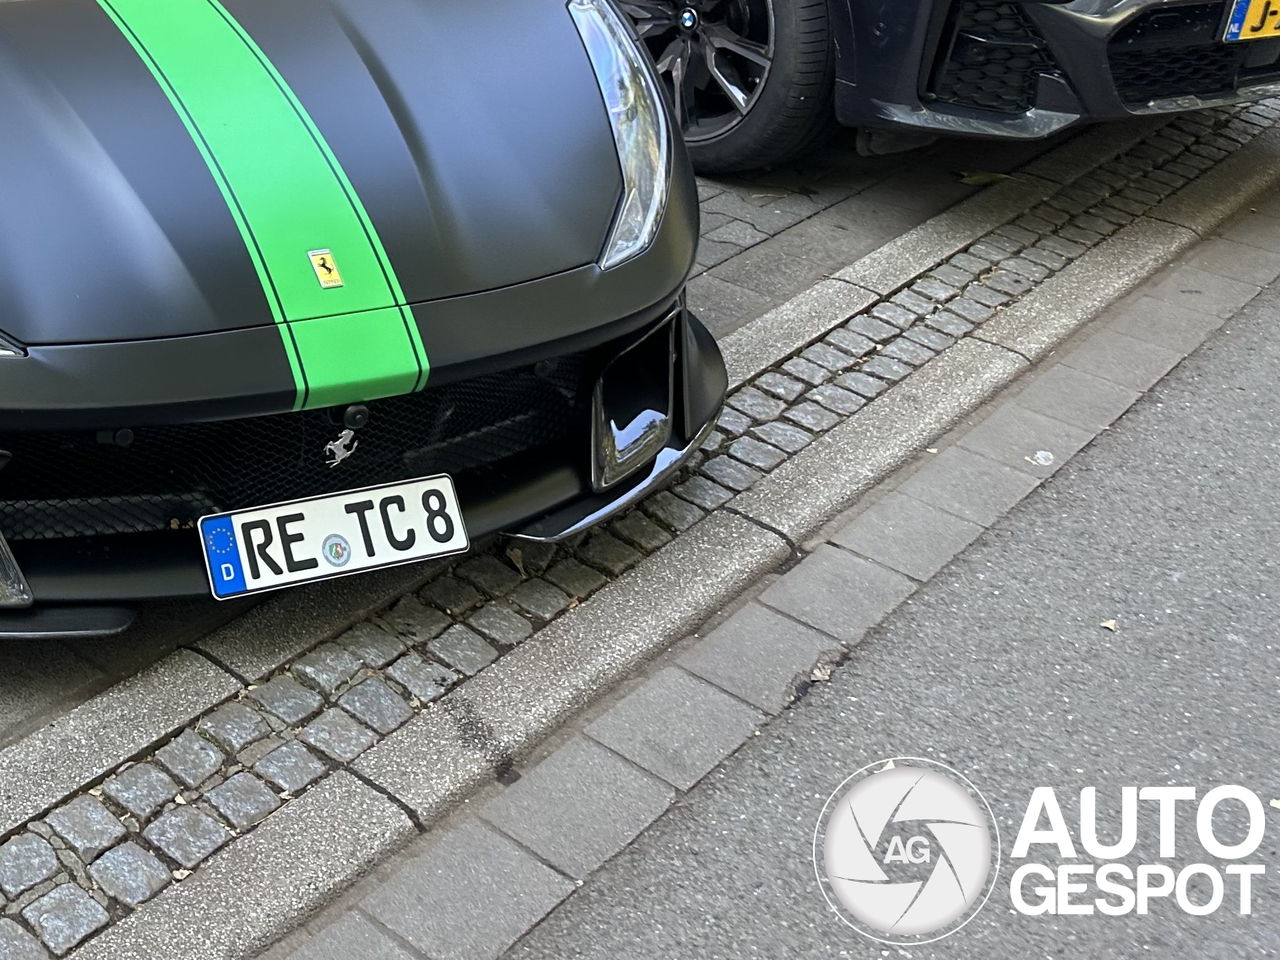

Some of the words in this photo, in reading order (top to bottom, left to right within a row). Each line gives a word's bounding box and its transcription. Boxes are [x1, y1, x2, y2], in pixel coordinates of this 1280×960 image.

[1227, 23, 1240, 33] NL
[241, 512, 319, 580] RE
[344, 494, 416, 558] TC
[421, 488, 455, 544] 8
[221, 563, 235, 581] D
